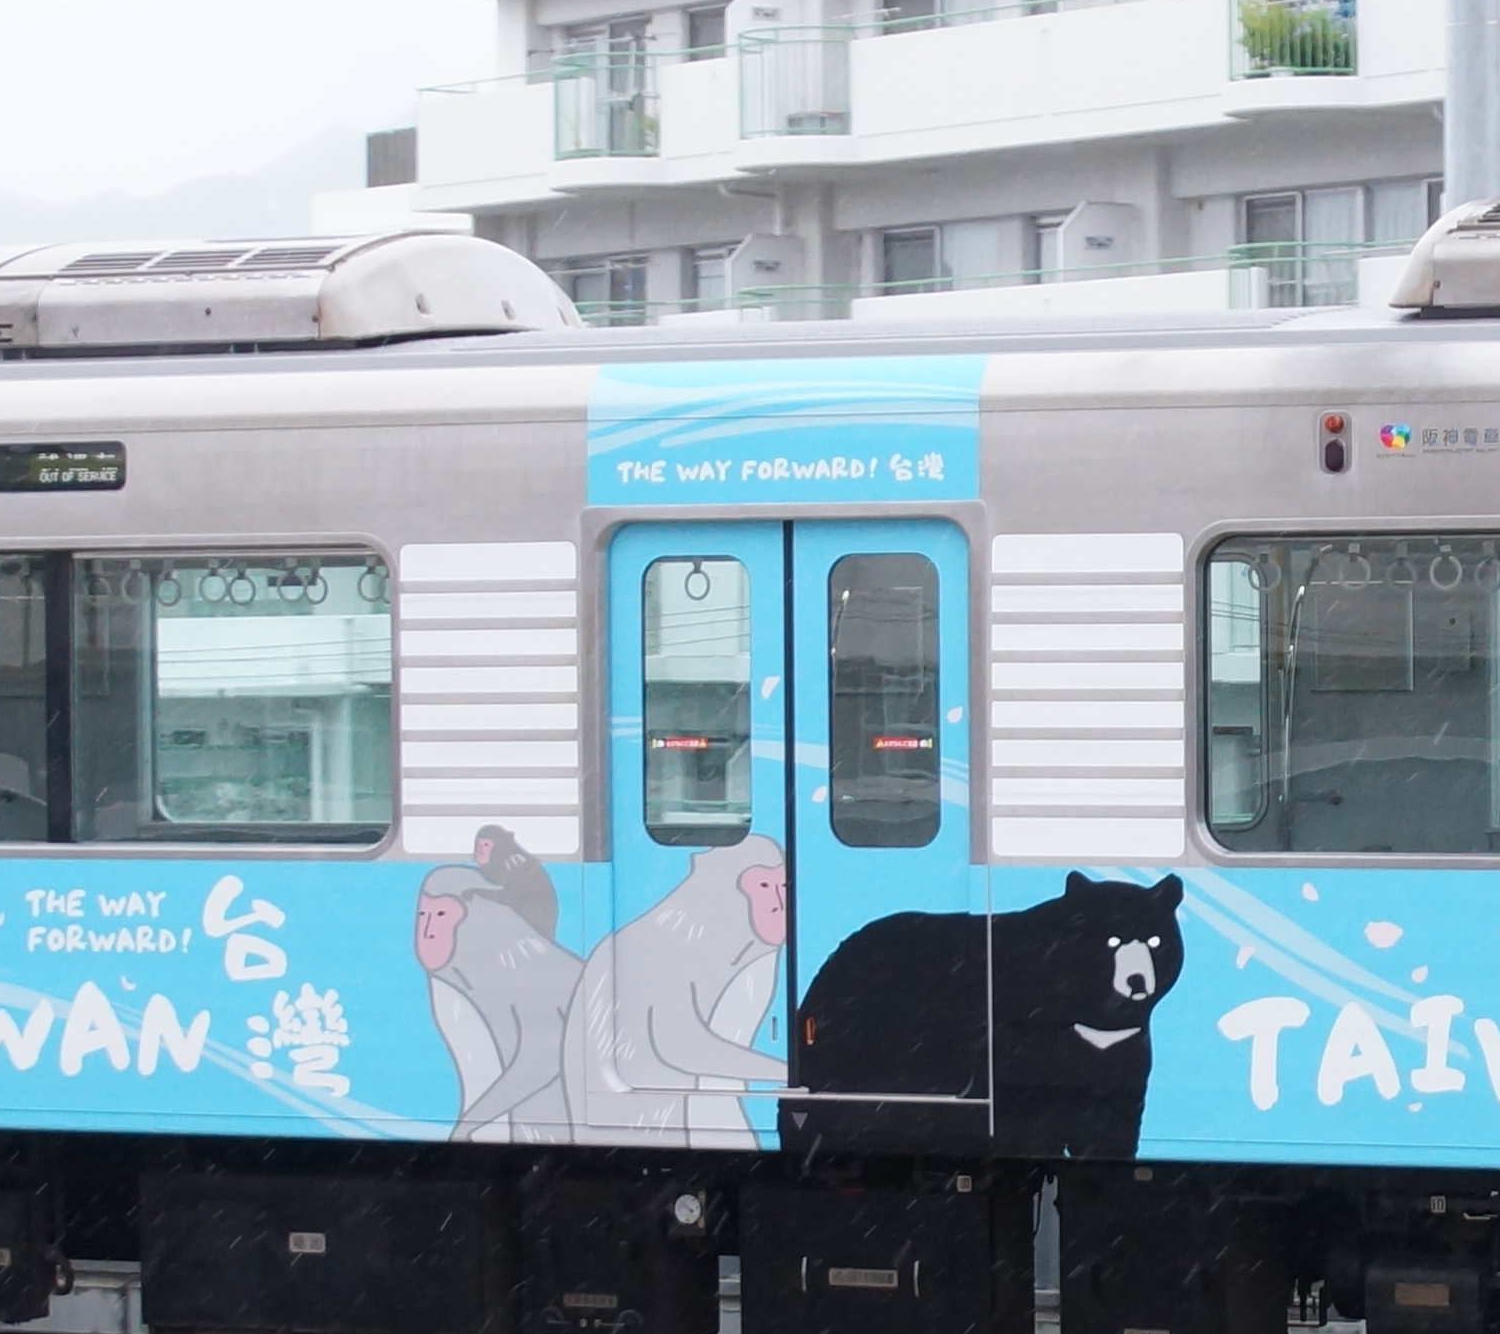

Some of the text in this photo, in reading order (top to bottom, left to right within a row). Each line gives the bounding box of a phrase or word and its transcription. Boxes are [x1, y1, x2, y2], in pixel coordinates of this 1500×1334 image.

[1422, 427, 1499, 447] 阪神電車
[39, 471, 59, 483] OUT
[616, 452, 945, 484] THE WAY FORWARD! 台灣
[25, 889, 166, 918] THE WAY
[28, 926, 194, 954] FORWARD!
